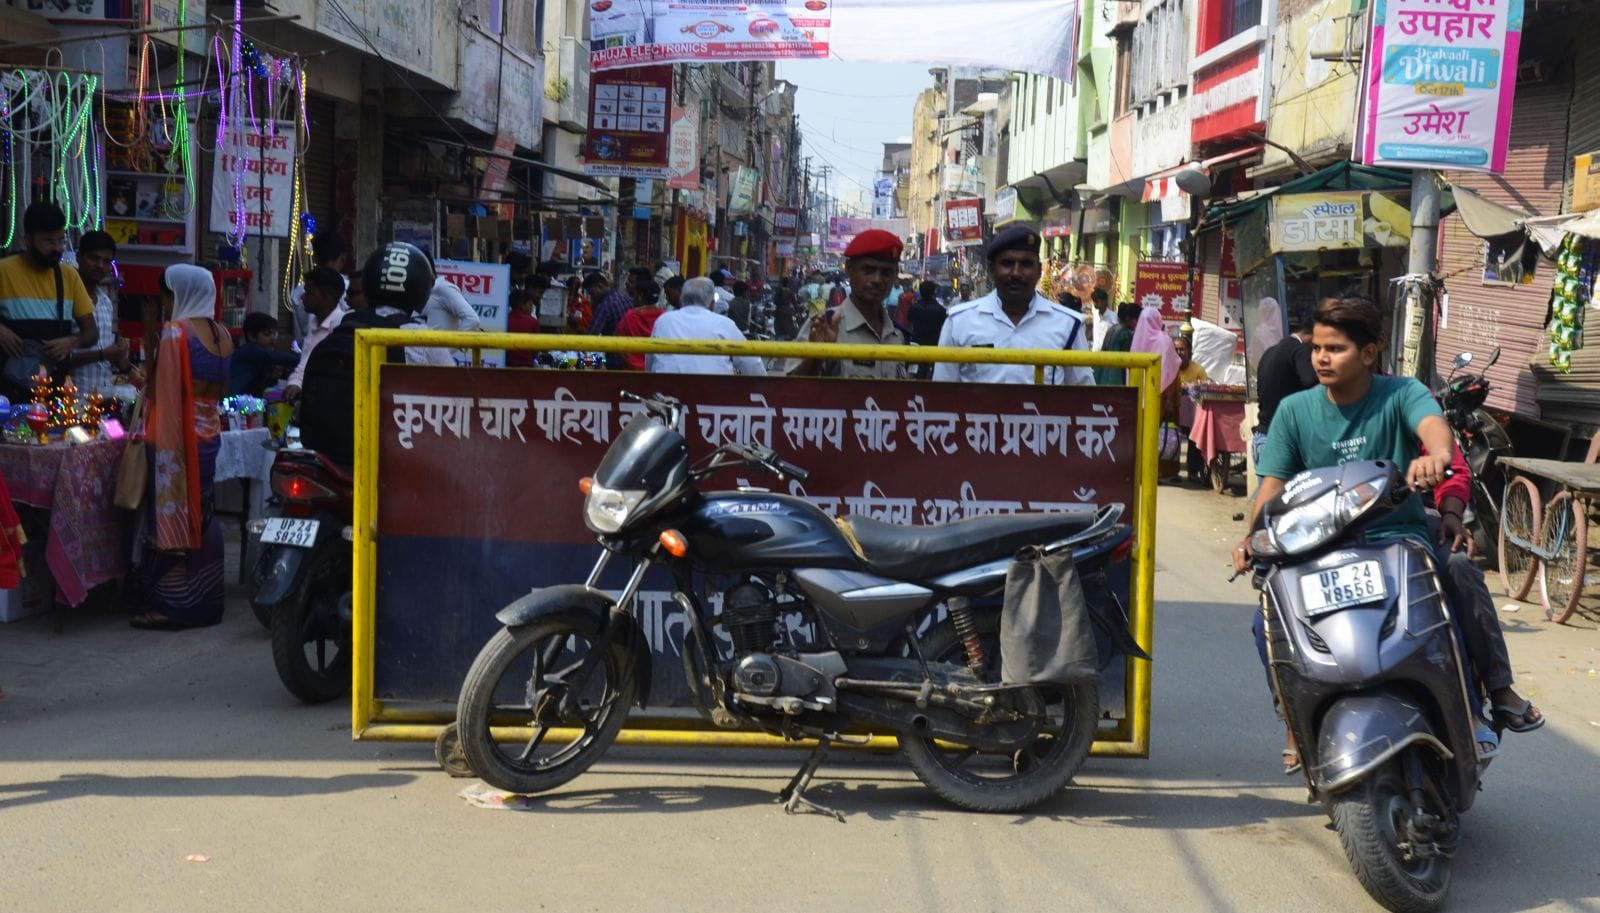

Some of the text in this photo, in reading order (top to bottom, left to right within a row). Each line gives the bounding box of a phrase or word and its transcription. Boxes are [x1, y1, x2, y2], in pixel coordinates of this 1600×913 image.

[1398, 10, 1496, 43] उपहार
[592, 47, 629, 62] AHUJA
[630, 42, 708, 58] ELECTRONICS
[1400, 56, 1486, 83] Diwali
[1403, 104, 1471, 136] उमेश
[1281, 208, 1358, 245] डोसा
[393, 393, 474, 450] कृपया
[479, 399, 528, 444] चार
[534, 386, 612, 446] पहिया
[696, 393, 777, 451] चलाते
[782, 407, 848, 451] समय
[852, 396, 900, 454] सीट
[965, 413, 999, 456] का
[1000, 402, 1072, 457] प्रयोग
[1075, 403, 1120, 464] करें
[274, 530, 311, 545] S8297
[280, 519, 313, 533] UP 24
[1320, 563, 1372, 588] UP 24
